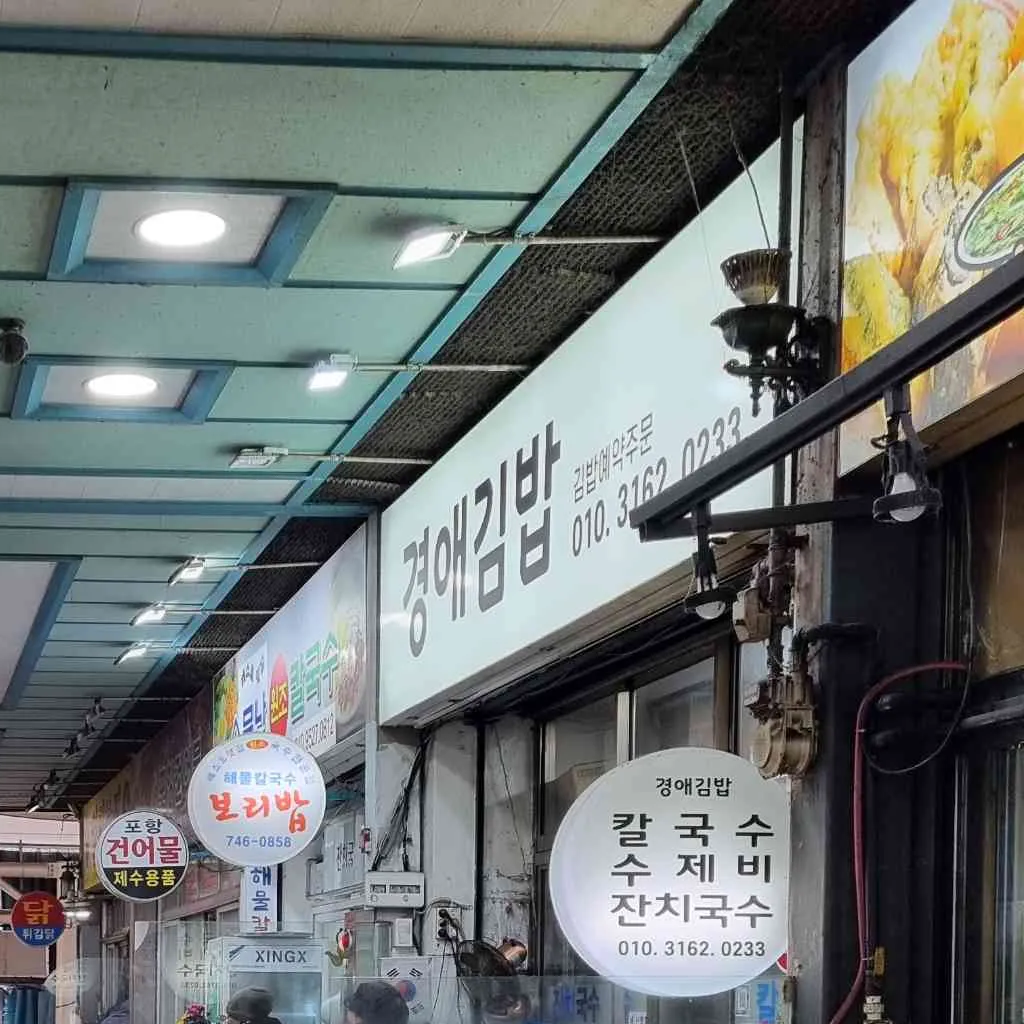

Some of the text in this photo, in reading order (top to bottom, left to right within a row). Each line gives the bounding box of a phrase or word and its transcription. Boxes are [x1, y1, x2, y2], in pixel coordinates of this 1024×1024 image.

[402, 420, 561, 657] 경애김밥
[223, 771, 297, 786] 해물칼국수
[655, 776, 733, 798] 경애김밥
[209, 790, 311, 834] 보리밥
[124, 818, 163, 835] 포항
[105, 836, 183, 865] 건어물
[225, 835, 293, 849] 746-0858
[113, 869, 177, 887] 제수용품
[23, 899, 54, 925] 닭
[610, 892, 774, 929] 잔치국수
[255, 949, 307, 964] XINGX
[721, 940, 766, 957] 0233
